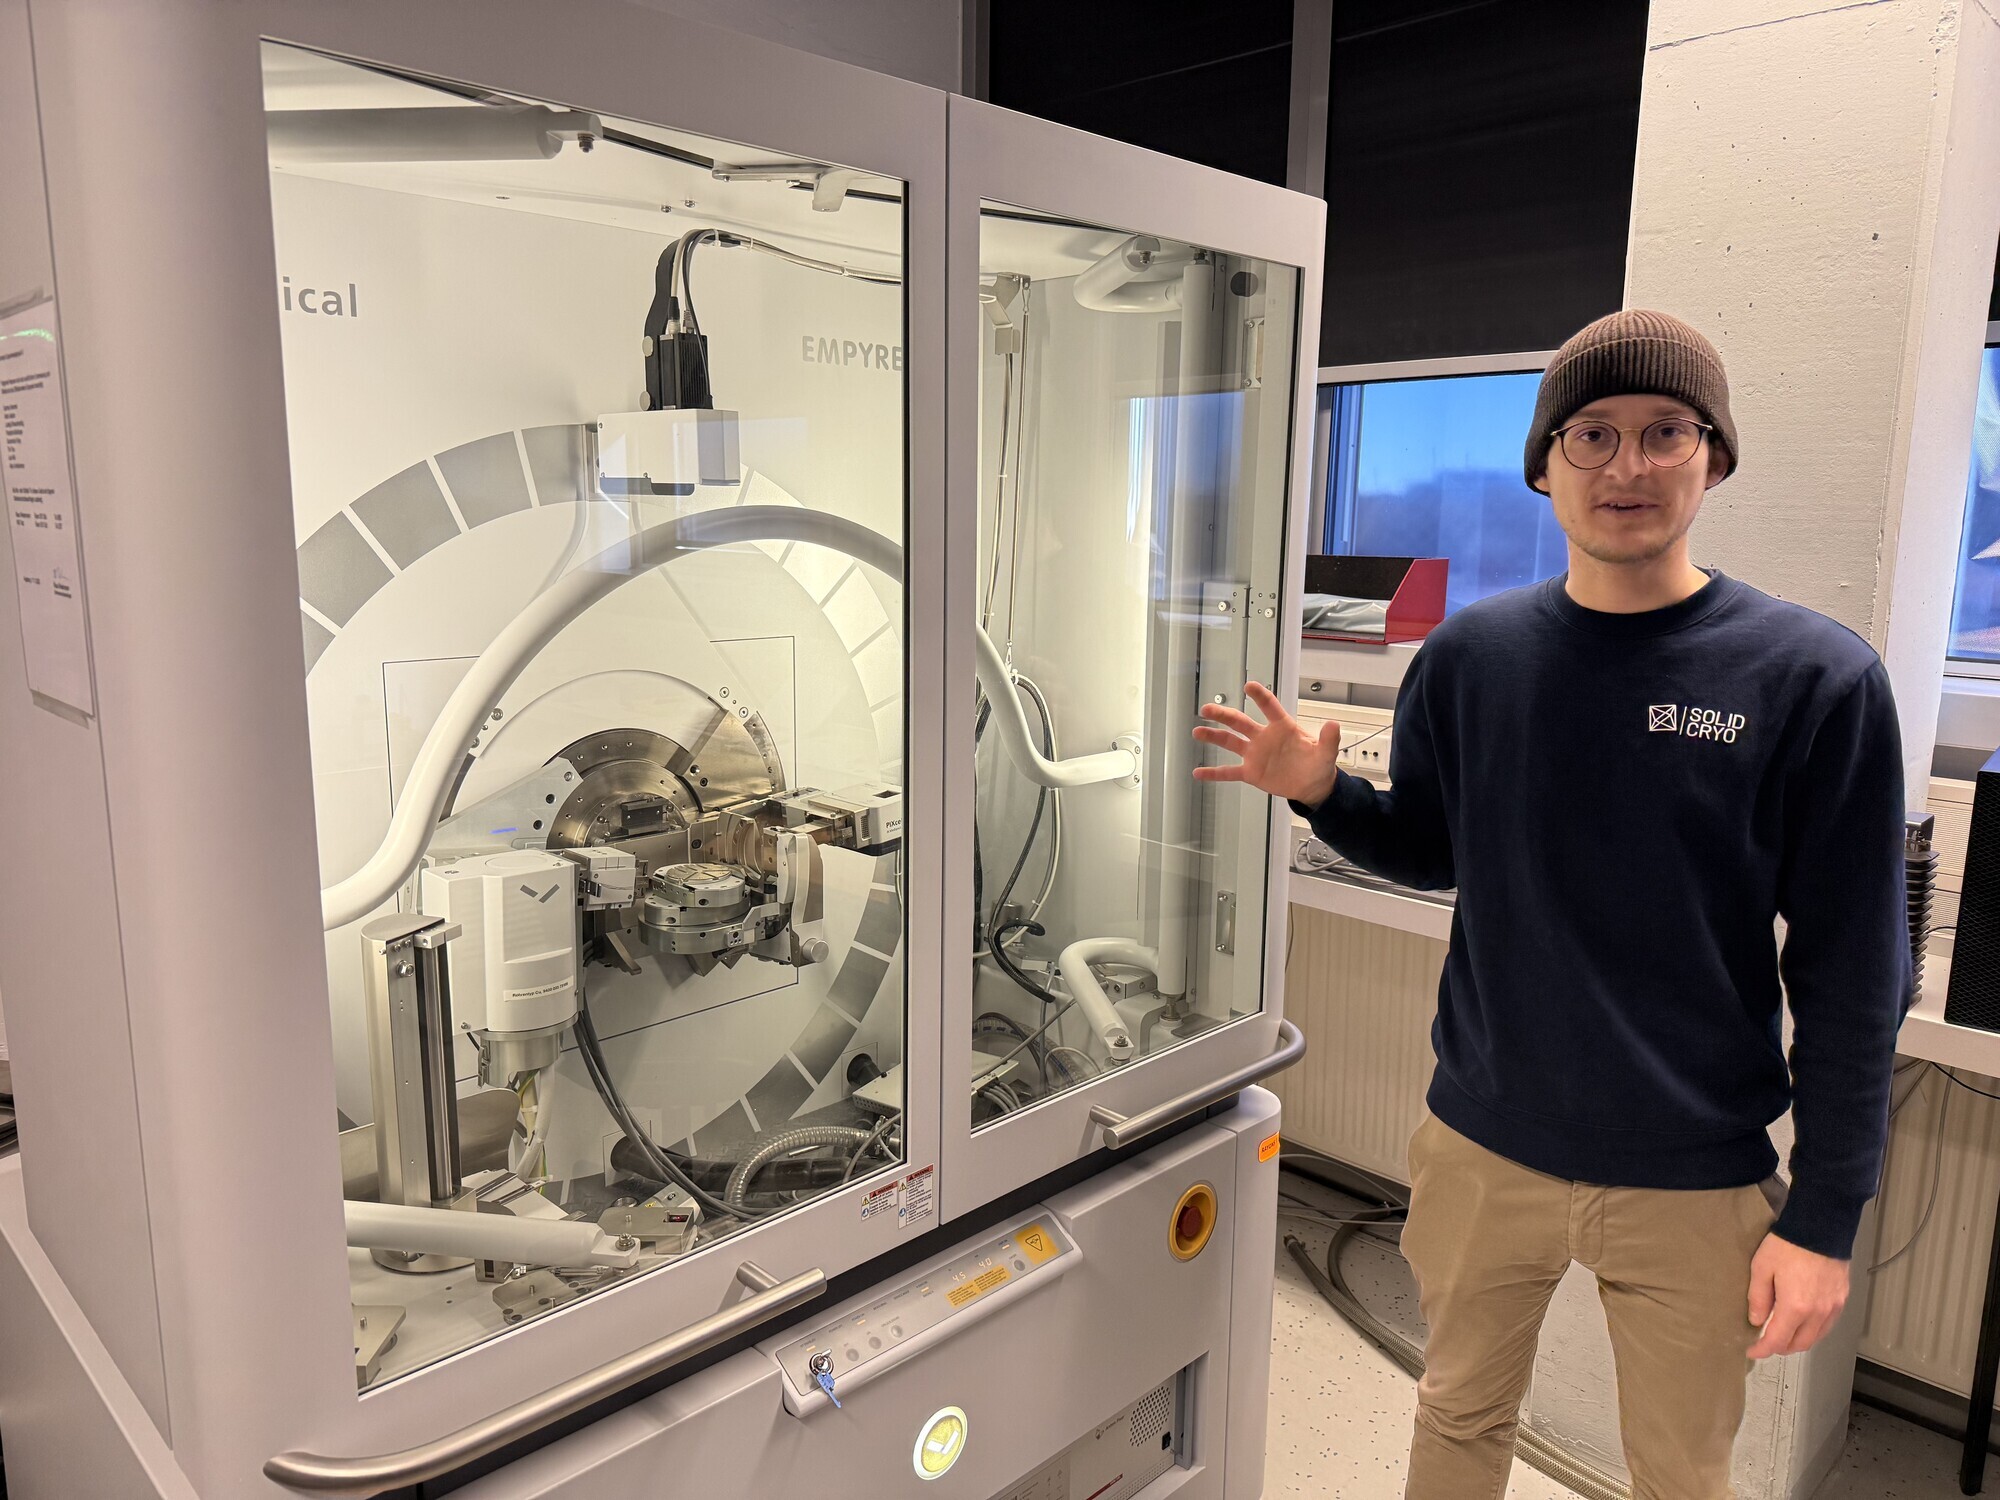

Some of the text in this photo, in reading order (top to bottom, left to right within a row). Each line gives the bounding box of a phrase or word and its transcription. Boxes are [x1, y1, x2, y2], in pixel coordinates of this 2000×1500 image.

[802, 335, 902, 372] EMPYRE
[1689, 707, 1746, 730] SOLID
[1686, 722, 1737, 744] CRYO
[952, 1271, 967, 1282] 45
[978, 1257, 993, 1268] 40
